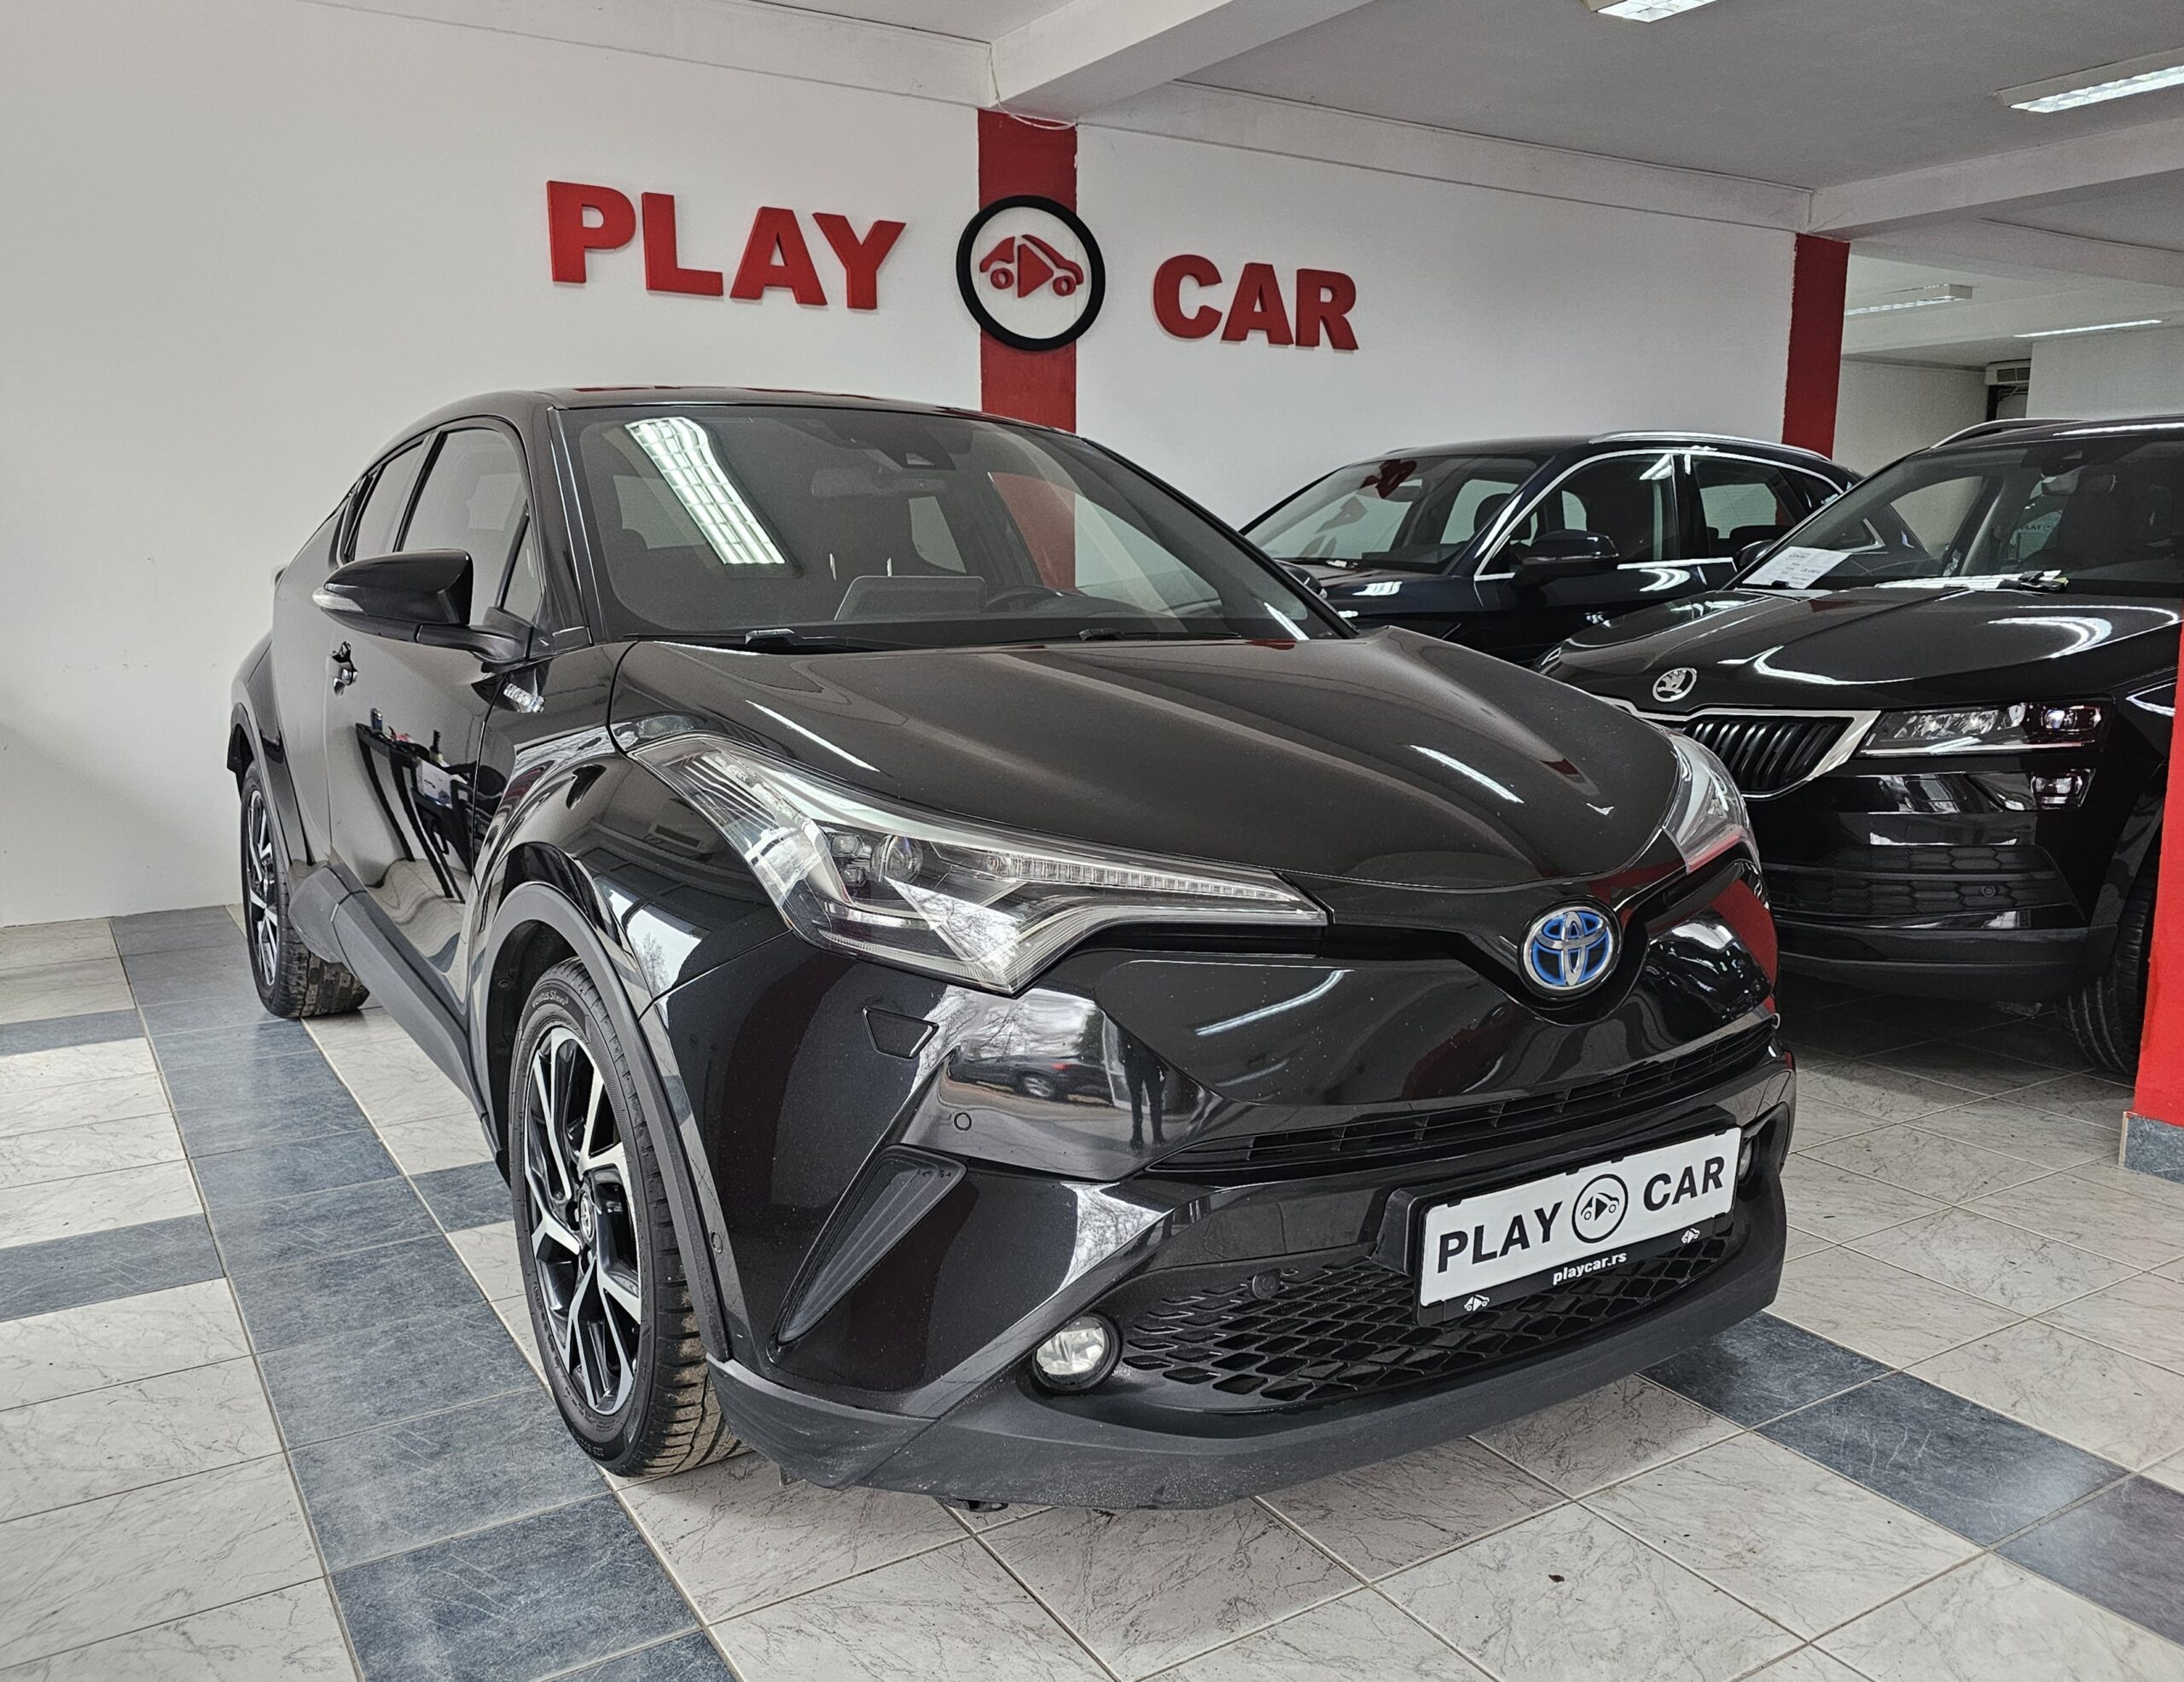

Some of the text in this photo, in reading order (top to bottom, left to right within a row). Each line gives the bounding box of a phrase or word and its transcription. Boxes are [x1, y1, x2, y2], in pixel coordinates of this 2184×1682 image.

[547, 180, 1359, 351] PLAY CAR
[1437, 1156, 1726, 1274] PLAY CAR
[1553, 1251, 1628, 1285] playcar.rs
